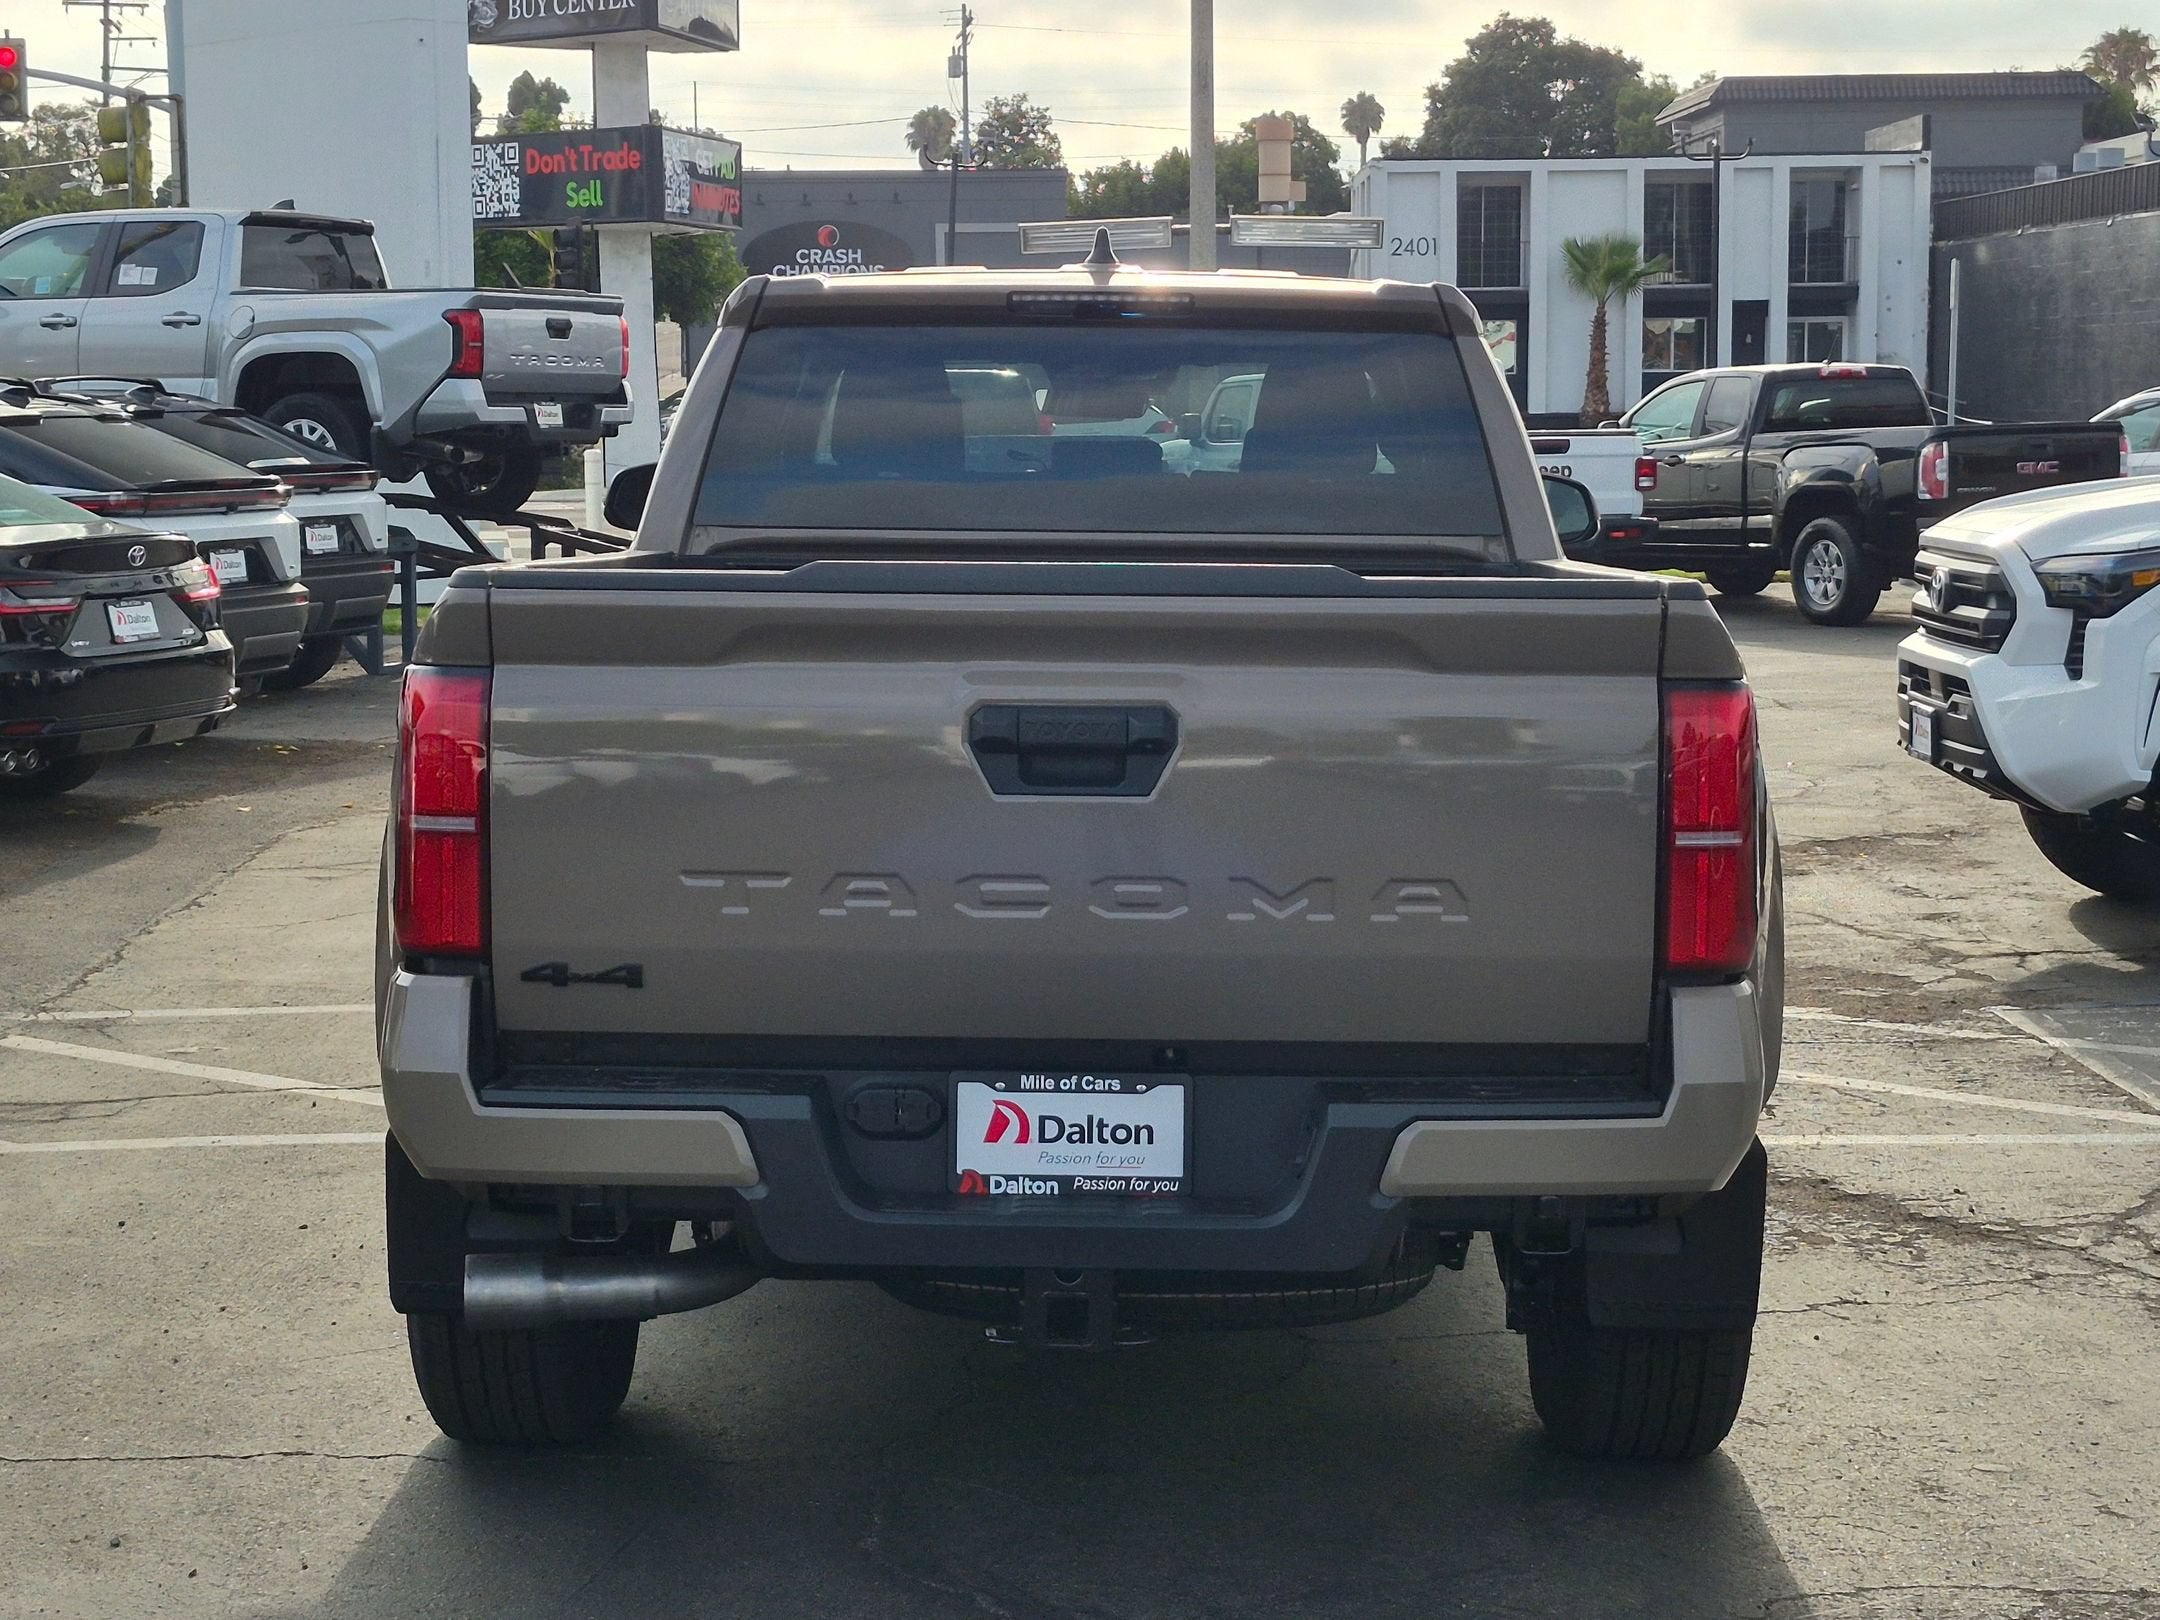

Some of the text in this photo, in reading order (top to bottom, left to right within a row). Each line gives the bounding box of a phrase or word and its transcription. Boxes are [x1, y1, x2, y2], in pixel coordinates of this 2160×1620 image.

[509, 0, 547, 20] BUY
[526, 142, 641, 174] Don't Trade
[566, 179, 603, 208] Sell
[795, 248, 862, 264] CRASH
[1391, 236, 1437, 256] 2401
[510, 354, 604, 367] TACOMA
[1539, 465, 1573, 478] eep
[2016, 460, 2060, 474] GMC
[678, 869, 1469, 923] TACOMA
[1020, 1074, 1121, 1092] Mile of Cars
[1037, 1114, 1154, 1145] Dalton
[1038, 1151, 1146, 1167] Passion for you
[989, 1175, 1179, 1195] Dalton Passion for you
